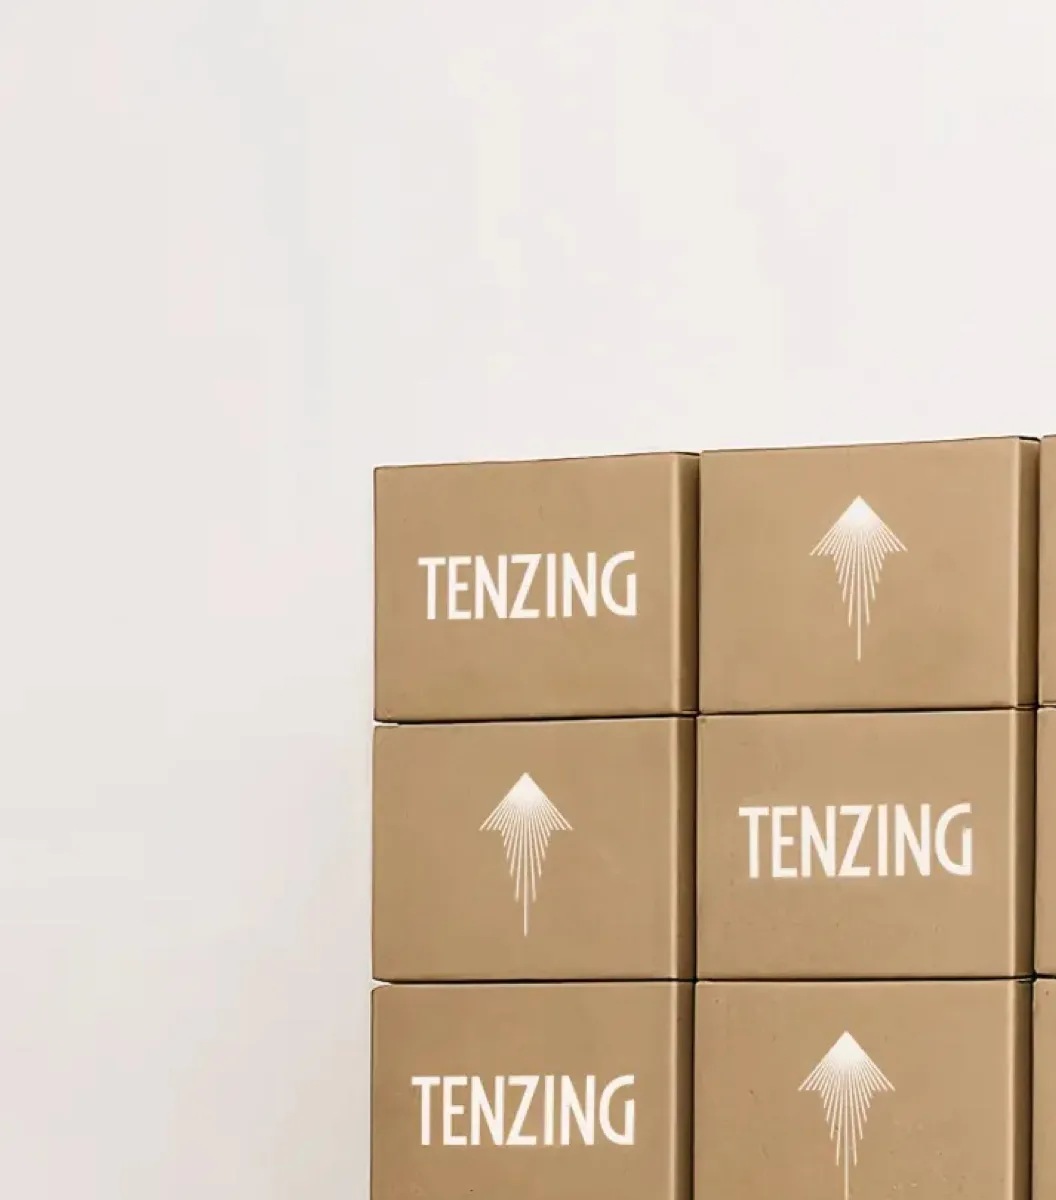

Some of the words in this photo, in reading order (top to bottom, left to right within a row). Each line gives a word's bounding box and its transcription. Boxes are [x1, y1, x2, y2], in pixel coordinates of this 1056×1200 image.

[417, 550, 637, 620] TENZING
[738, 802, 973, 879] TENZING
[411, 1074, 635, 1146] TENZING
